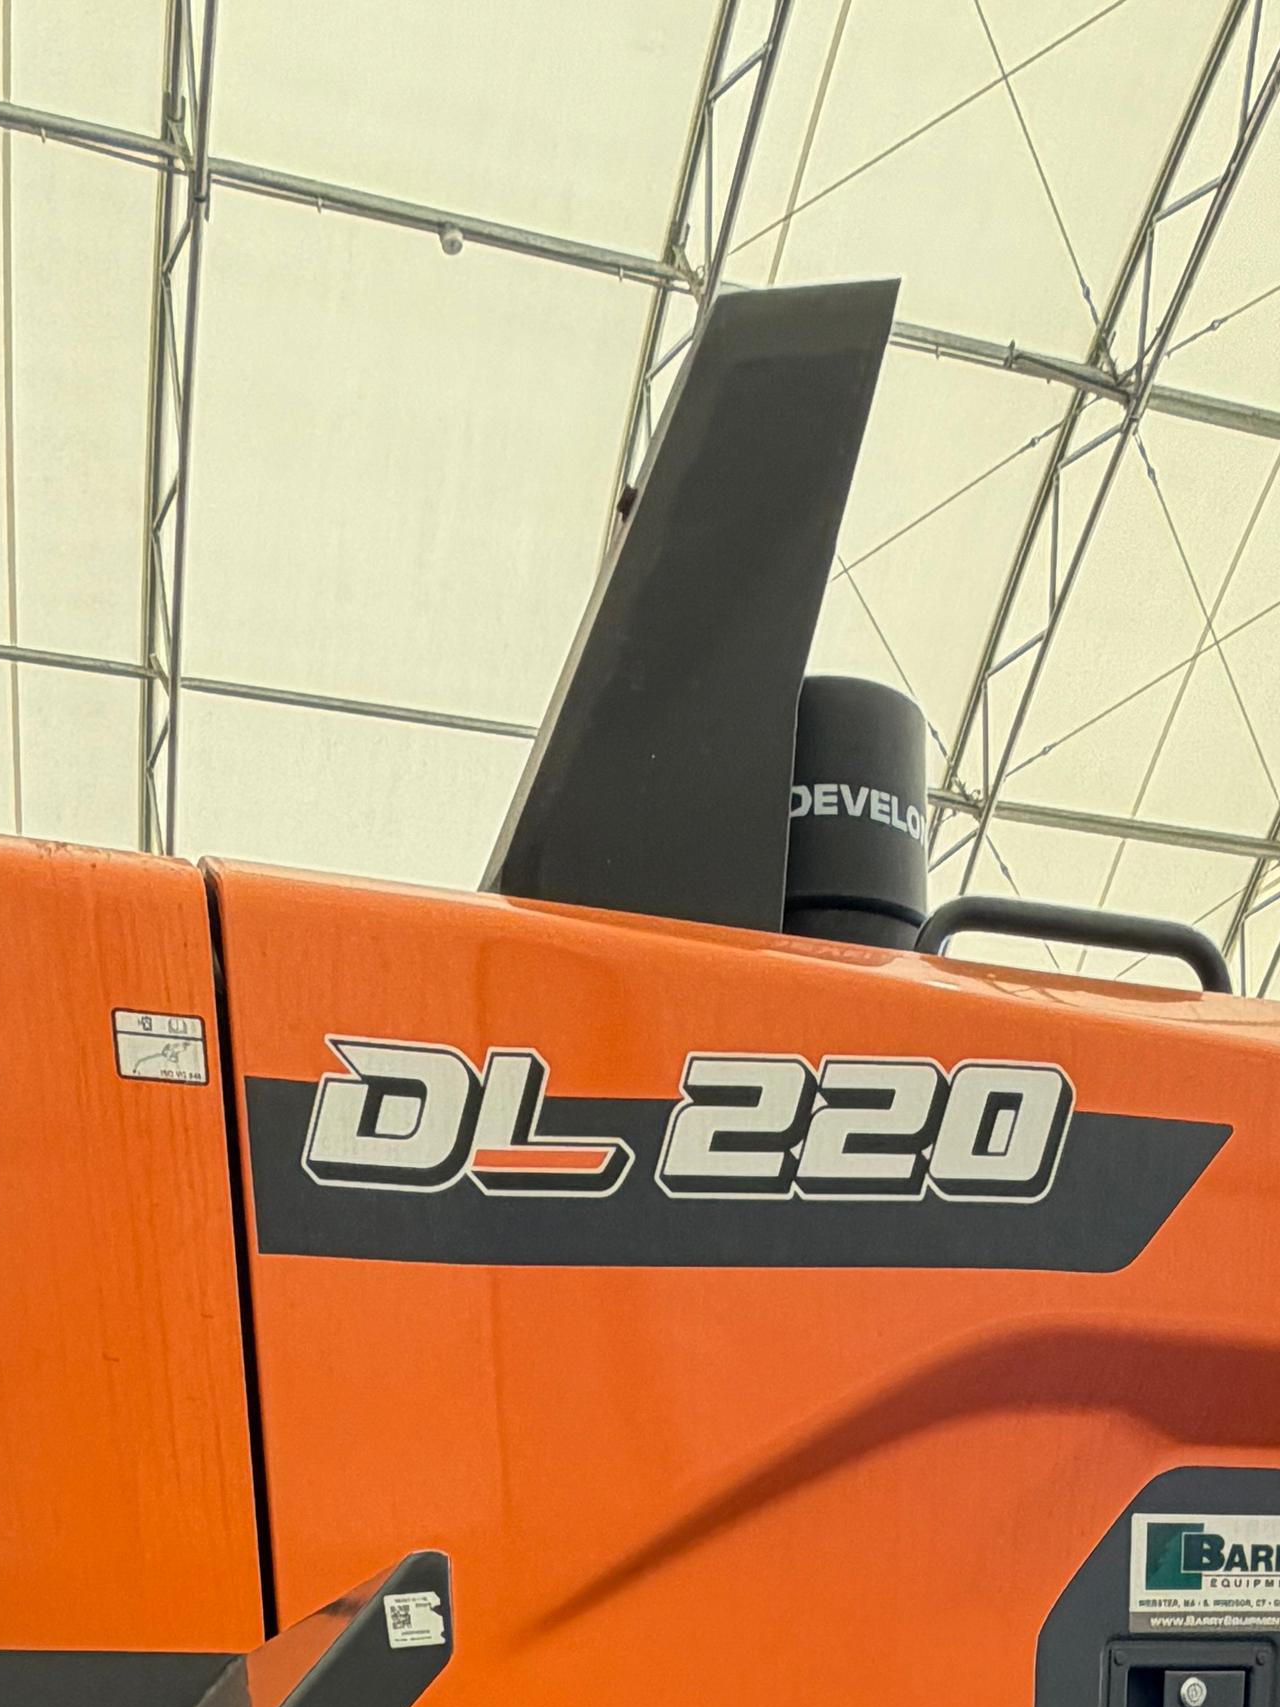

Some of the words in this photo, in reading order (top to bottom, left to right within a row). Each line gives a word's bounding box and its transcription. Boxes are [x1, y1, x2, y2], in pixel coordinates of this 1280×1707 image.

[789, 783, 926, 847] DEVELO
[302, 1034, 634, 1196] DL
[654, 1052, 1076, 1203] 220
